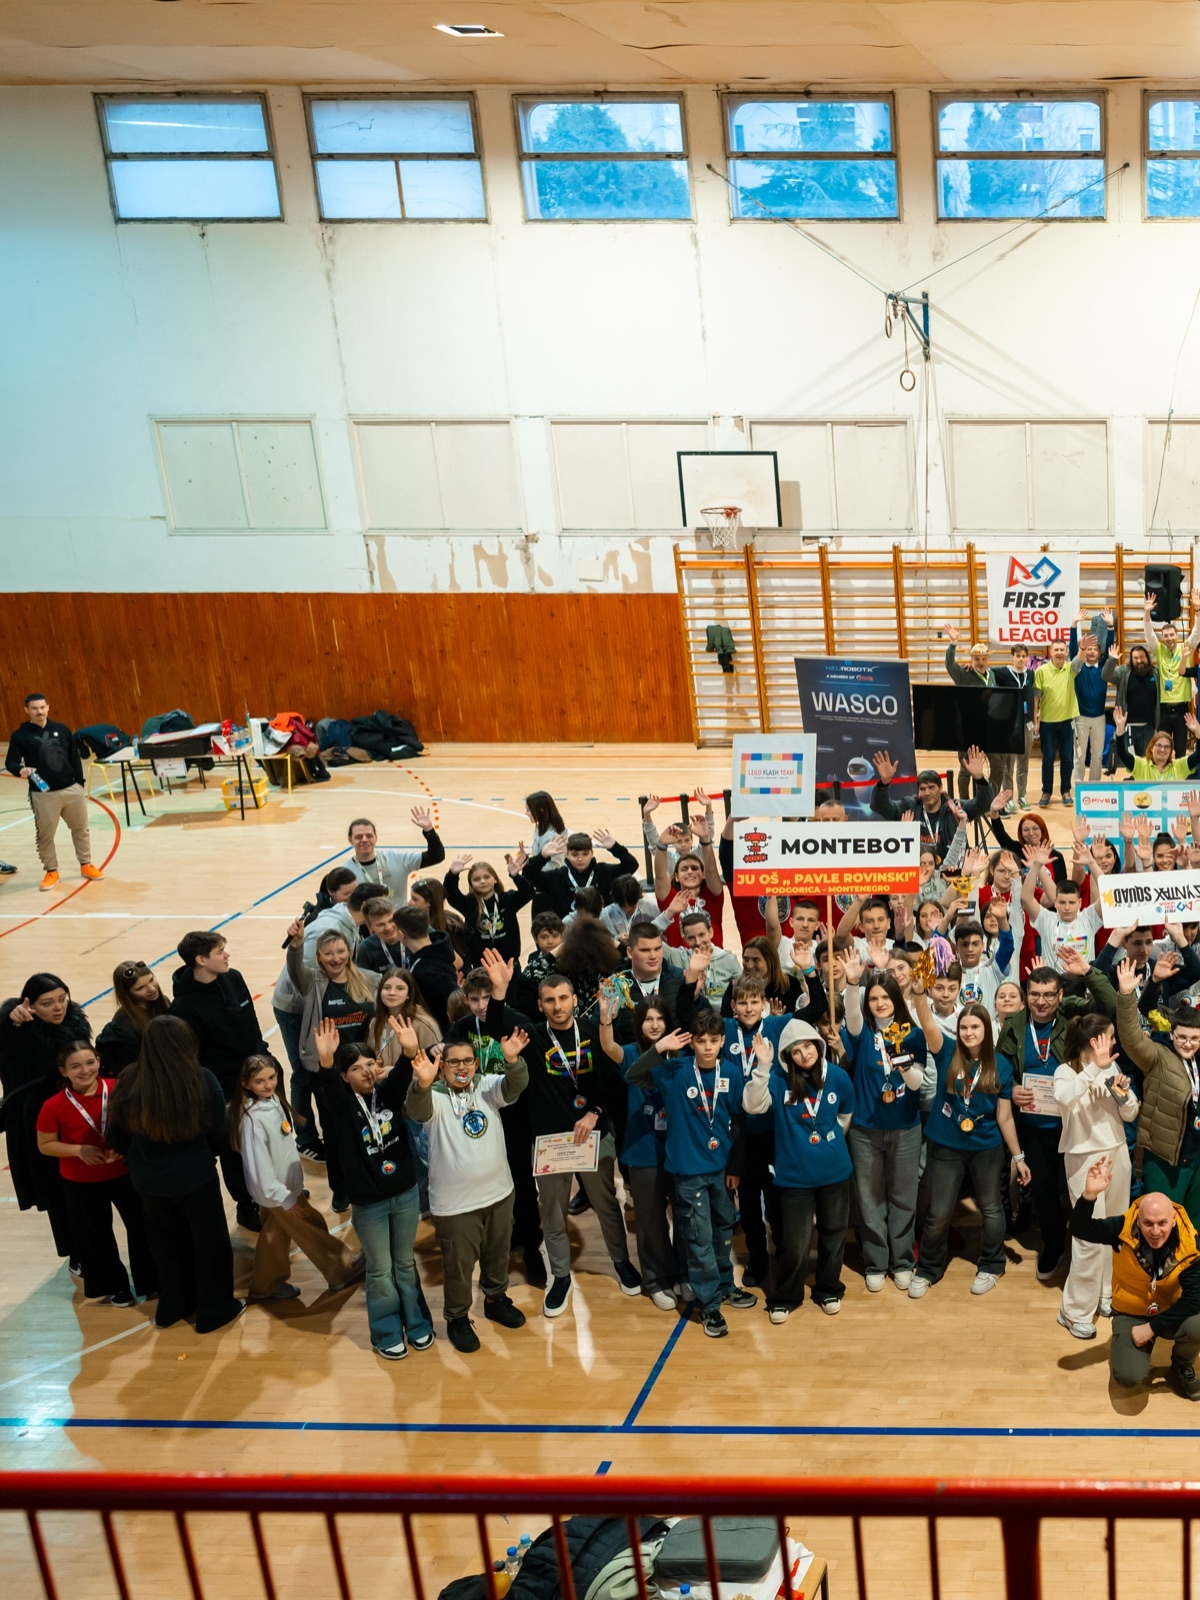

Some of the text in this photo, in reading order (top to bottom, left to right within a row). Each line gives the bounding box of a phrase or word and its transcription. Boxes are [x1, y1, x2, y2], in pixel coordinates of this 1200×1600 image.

[1003, 591, 1065, 608] FIRST
[1008, 610, 1058, 625] LEGO
[998, 627, 1071, 643] LEAGUE
[811, 691, 898, 716] WASCO
[780, 837, 915, 855] MONTEBOT
[737, 874, 755, 885] JU
[759, 871, 779, 885] OŠ
[794, 873, 839, 884] PAVLE
[843, 871, 917, 884] ROVINSKI”
[765, 886, 820, 894] PODGORICA
[828, 884, 890, 893] MONTENEGRO
[1113, 885, 1152, 903] SQUAD
